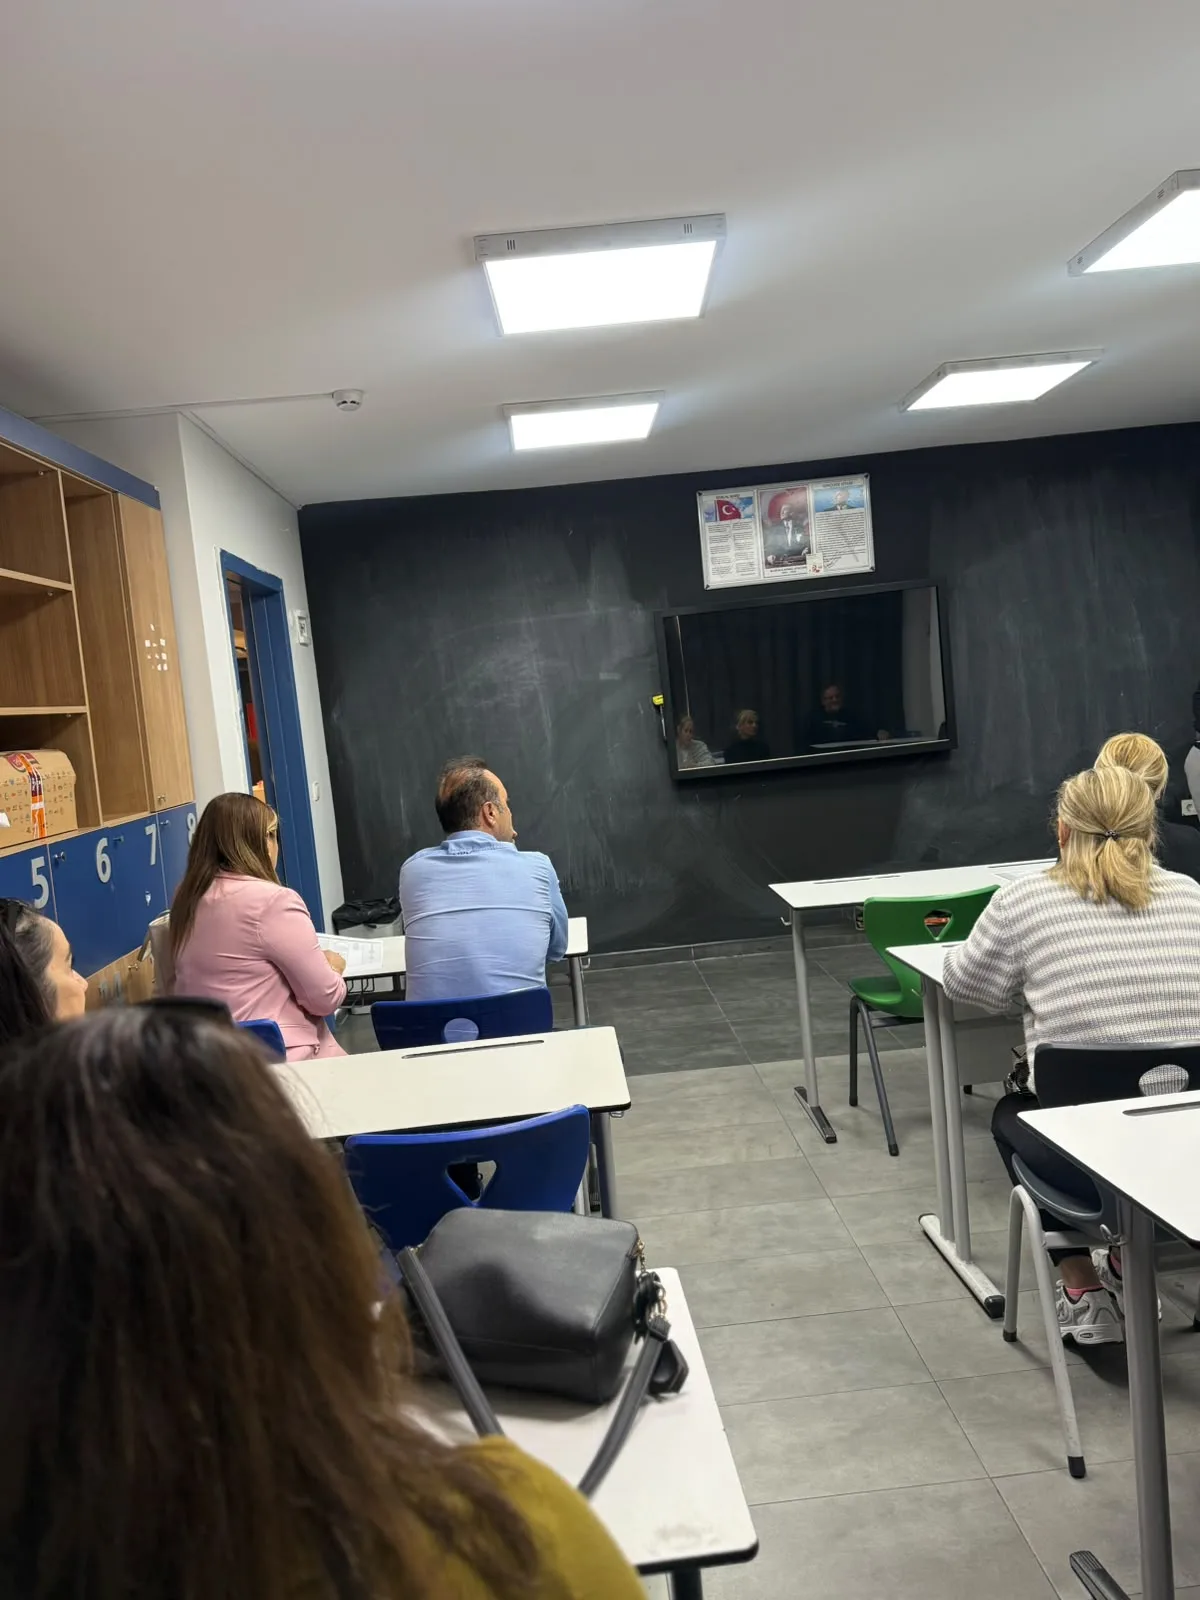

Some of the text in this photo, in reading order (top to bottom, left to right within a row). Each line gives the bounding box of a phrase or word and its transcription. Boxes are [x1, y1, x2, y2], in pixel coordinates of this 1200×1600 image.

[95, 837, 112, 884] 6
[144, 823, 157, 866] 7
[31, 856, 50, 909] 5
